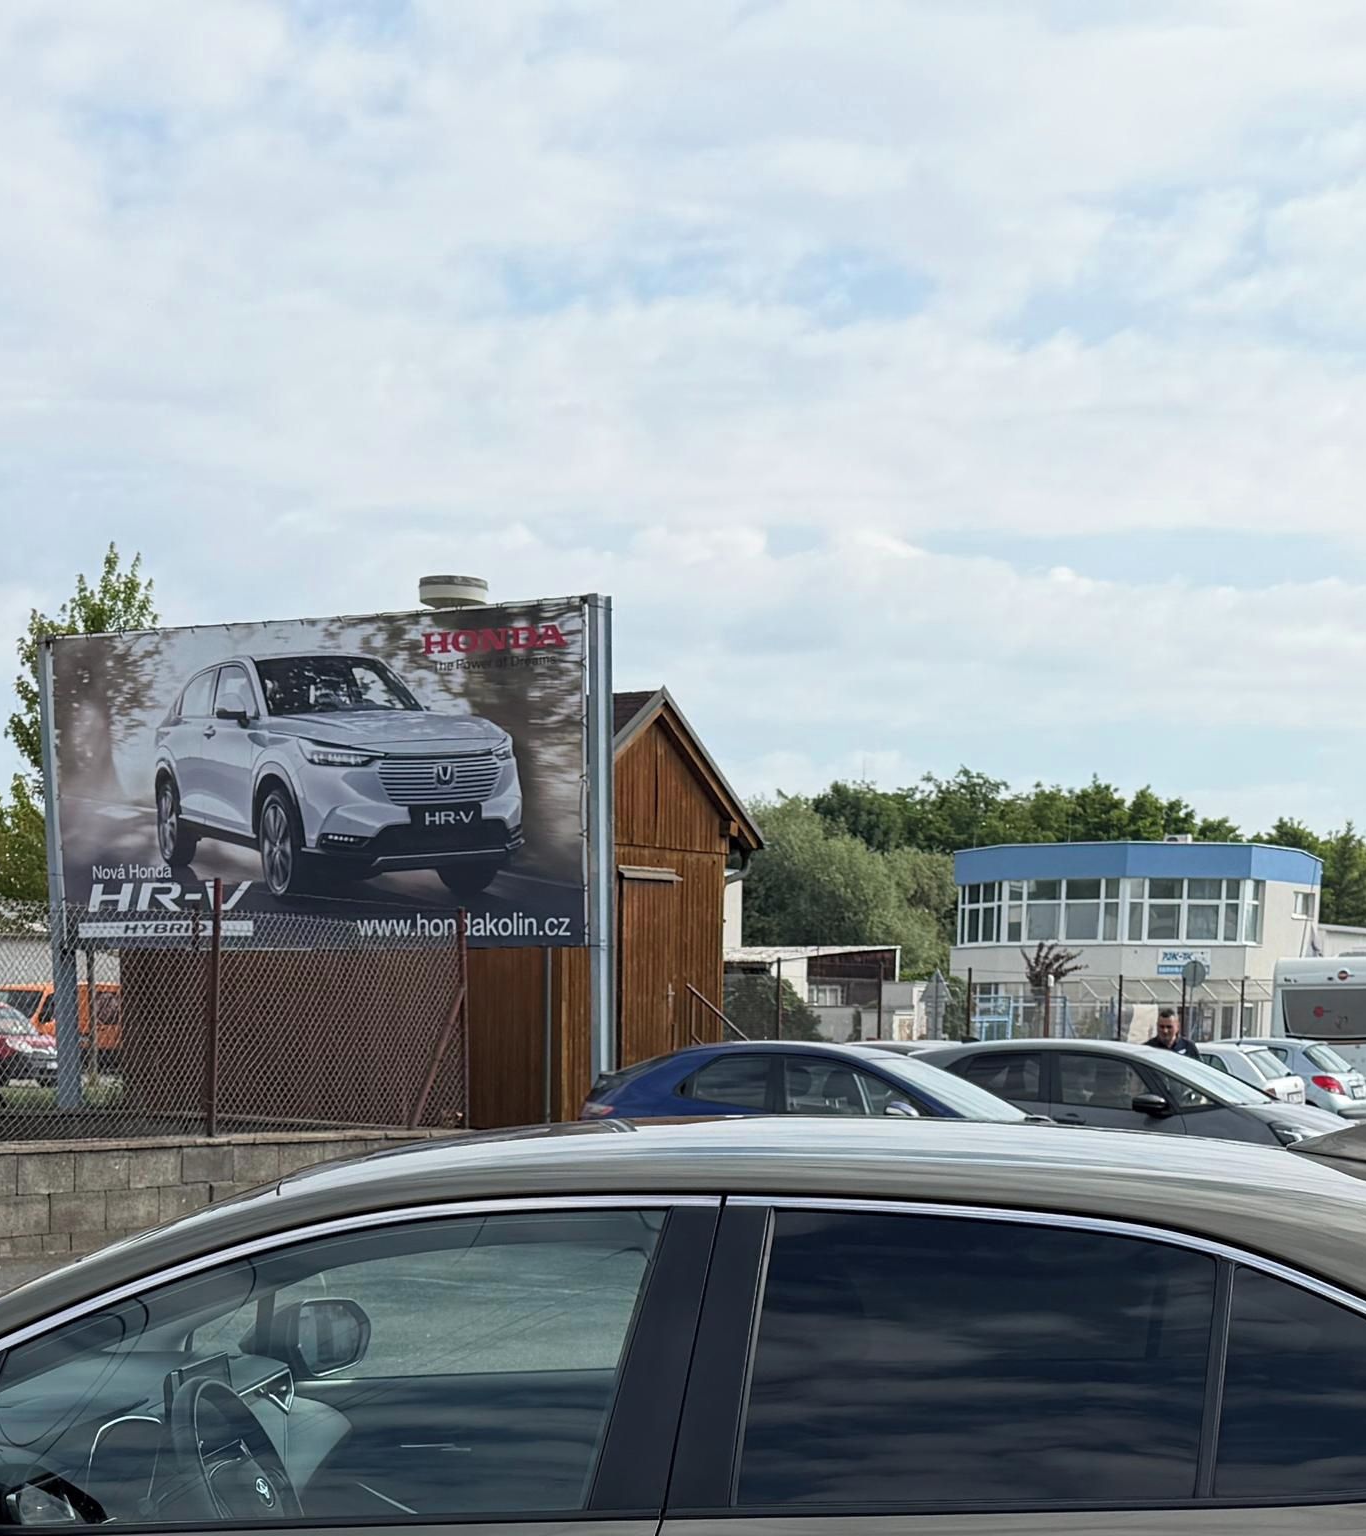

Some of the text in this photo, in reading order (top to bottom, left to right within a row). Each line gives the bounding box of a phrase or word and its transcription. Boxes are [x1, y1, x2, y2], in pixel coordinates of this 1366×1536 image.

[421, 624, 569, 657] HONDA
[455, 659, 492, 671] Power
[497, 657, 508, 669] of
[510, 654, 557, 668] Dreams
[424, 809, 475, 826] HR-V
[92, 863, 173, 881] Nová Honda
[88, 880, 254, 913] HR-V
[356, 911, 572, 937] www.hondakolin.cz
